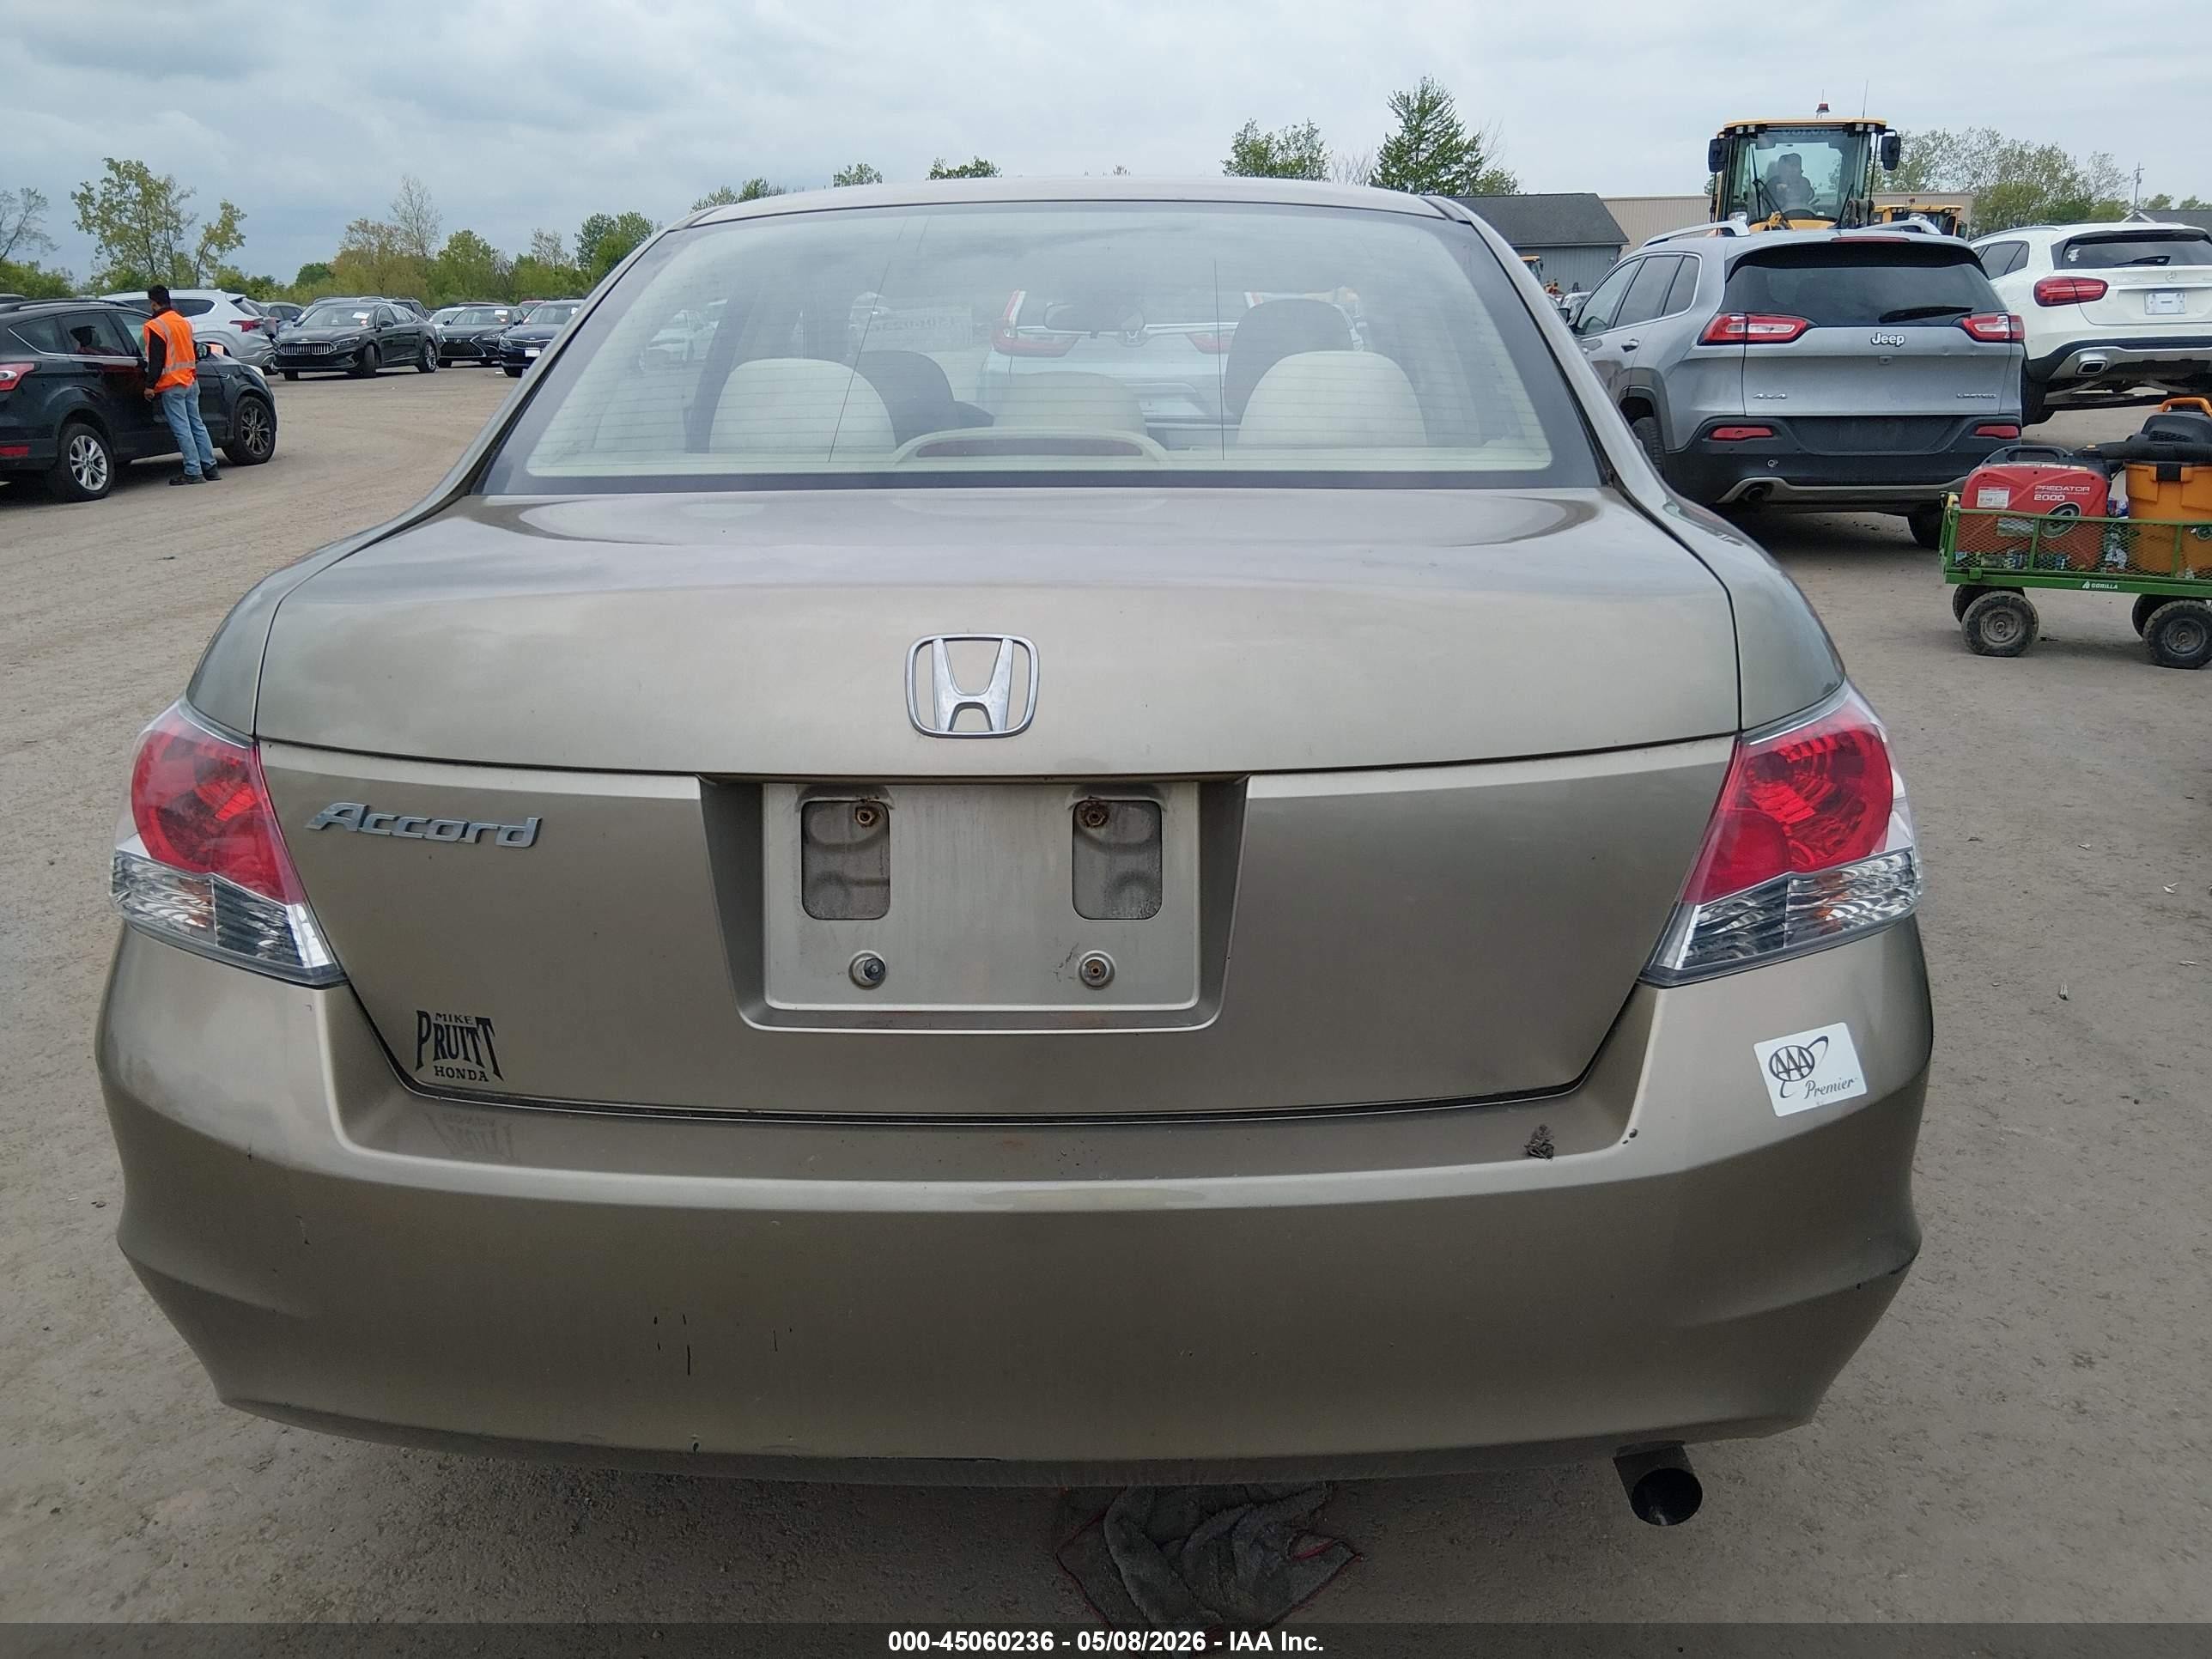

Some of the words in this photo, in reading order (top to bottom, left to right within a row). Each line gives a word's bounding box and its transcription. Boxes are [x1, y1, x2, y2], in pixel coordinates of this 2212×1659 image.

[1871, 332, 1906, 347] Jeep
[305, 801, 543, 848] Accord
[434, 1012, 474, 1025] MIKE
[415, 1010, 505, 1082] PRUITT
[433, 1066, 489, 1083] HONDA
[1774, 1046, 1814, 1080] AAA
[1803, 1077, 1856, 1100] Premier
